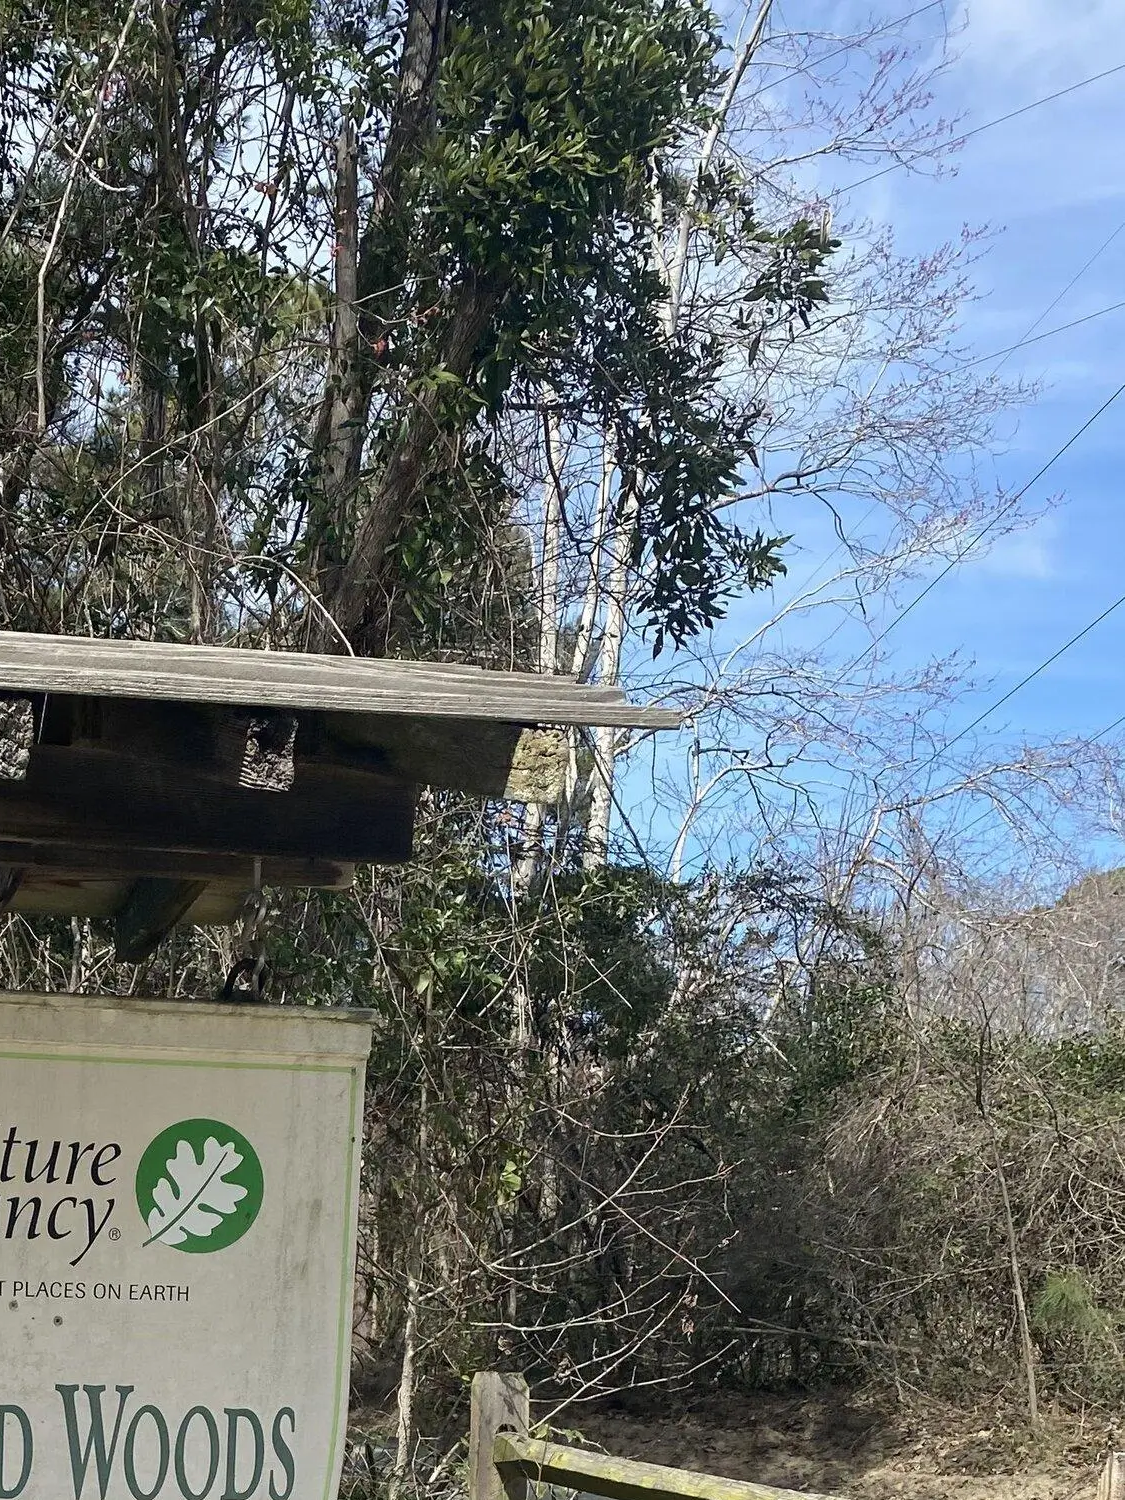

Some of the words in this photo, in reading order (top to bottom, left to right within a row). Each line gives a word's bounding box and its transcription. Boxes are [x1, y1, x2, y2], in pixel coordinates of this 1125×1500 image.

[14, 1281, 86, 1299] PLACES
[93, 1283, 123, 1301] ON
[129, 1284, 191, 1302] EARTH
